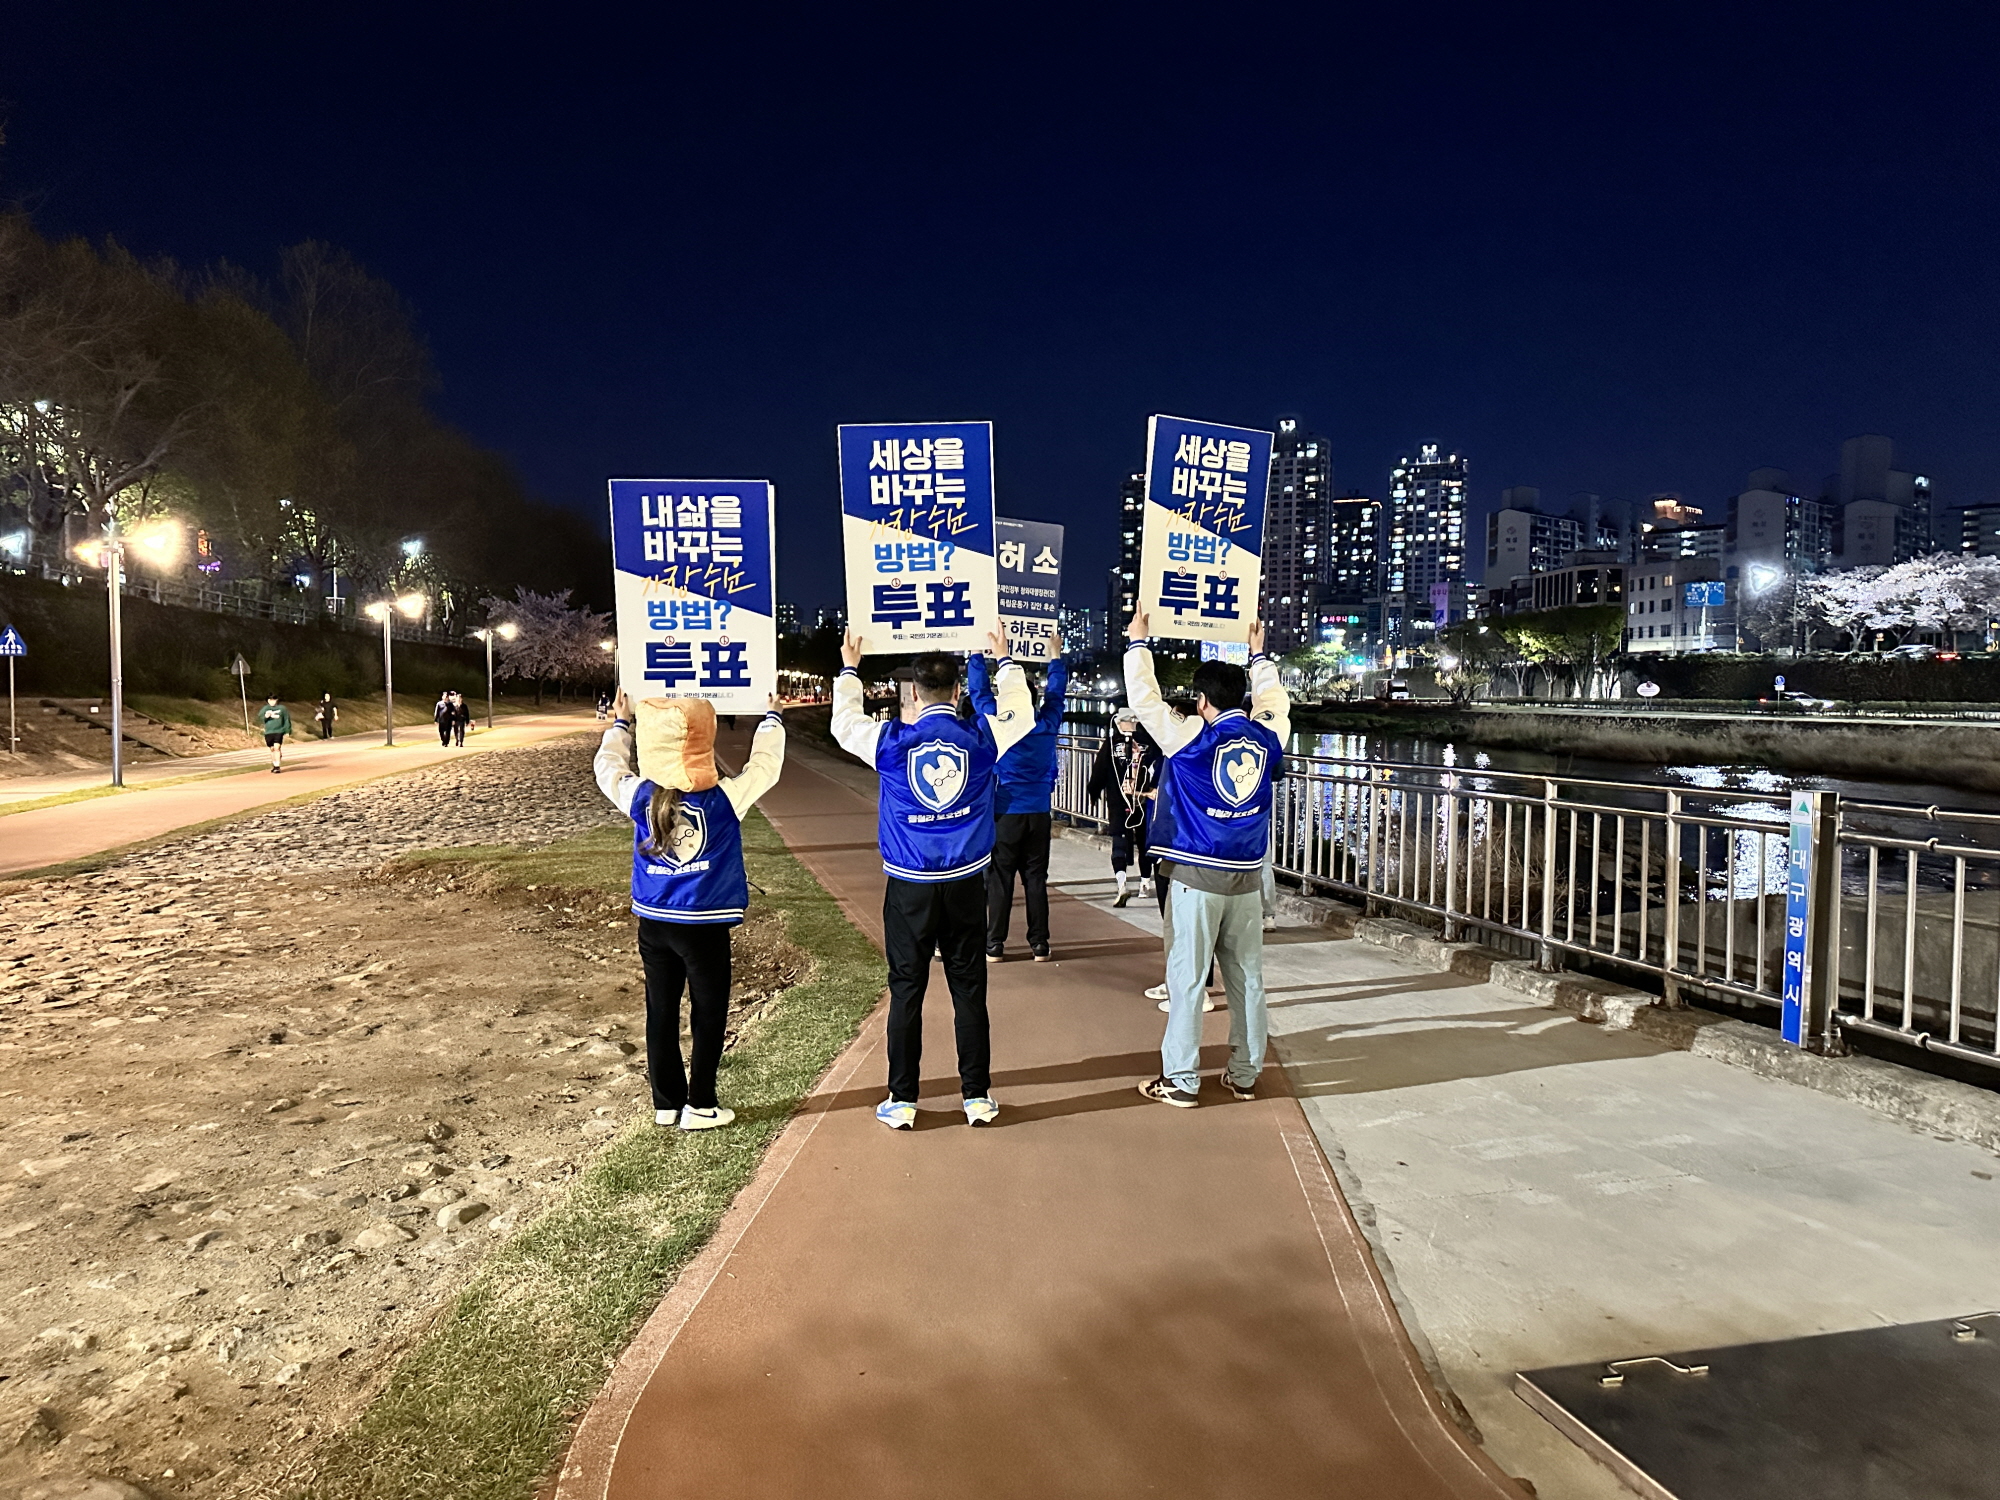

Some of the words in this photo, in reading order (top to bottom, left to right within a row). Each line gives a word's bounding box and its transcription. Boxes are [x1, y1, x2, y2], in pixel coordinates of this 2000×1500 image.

[869, 438, 965, 471] 세상을
[1175, 434, 1251, 472] 세상을
[870, 473, 966, 505] 바꾸는
[1172, 467, 1247, 504] 바꾸는
[869, 508, 927, 541] 가장
[928, 501, 979, 539] 쉬운
[1166, 501, 1214, 532] 가장
[1213, 501, 1253, 534] 쉬운
[643, 531, 743, 562] 바꾸는
[874, 541, 955, 573] 방법?
[1168, 532, 1232, 565] 방법?
[641, 565, 702, 598] 가장
[703, 559, 757, 597] 쉬운
[871, 582, 975, 629] 투표
[1000, 598, 1029, 609] 독립운동가
[1030, 601, 1042, 611] 집안
[1043, 603, 1055, 612] 후손
[1159, 571, 1240, 620] 투표
[647, 600, 732, 630] 방법?
[1010, 620, 1053, 638] 하루도
[644, 642, 751, 688] 투표
[1785, 849, 1807, 1007] 대구광역시
